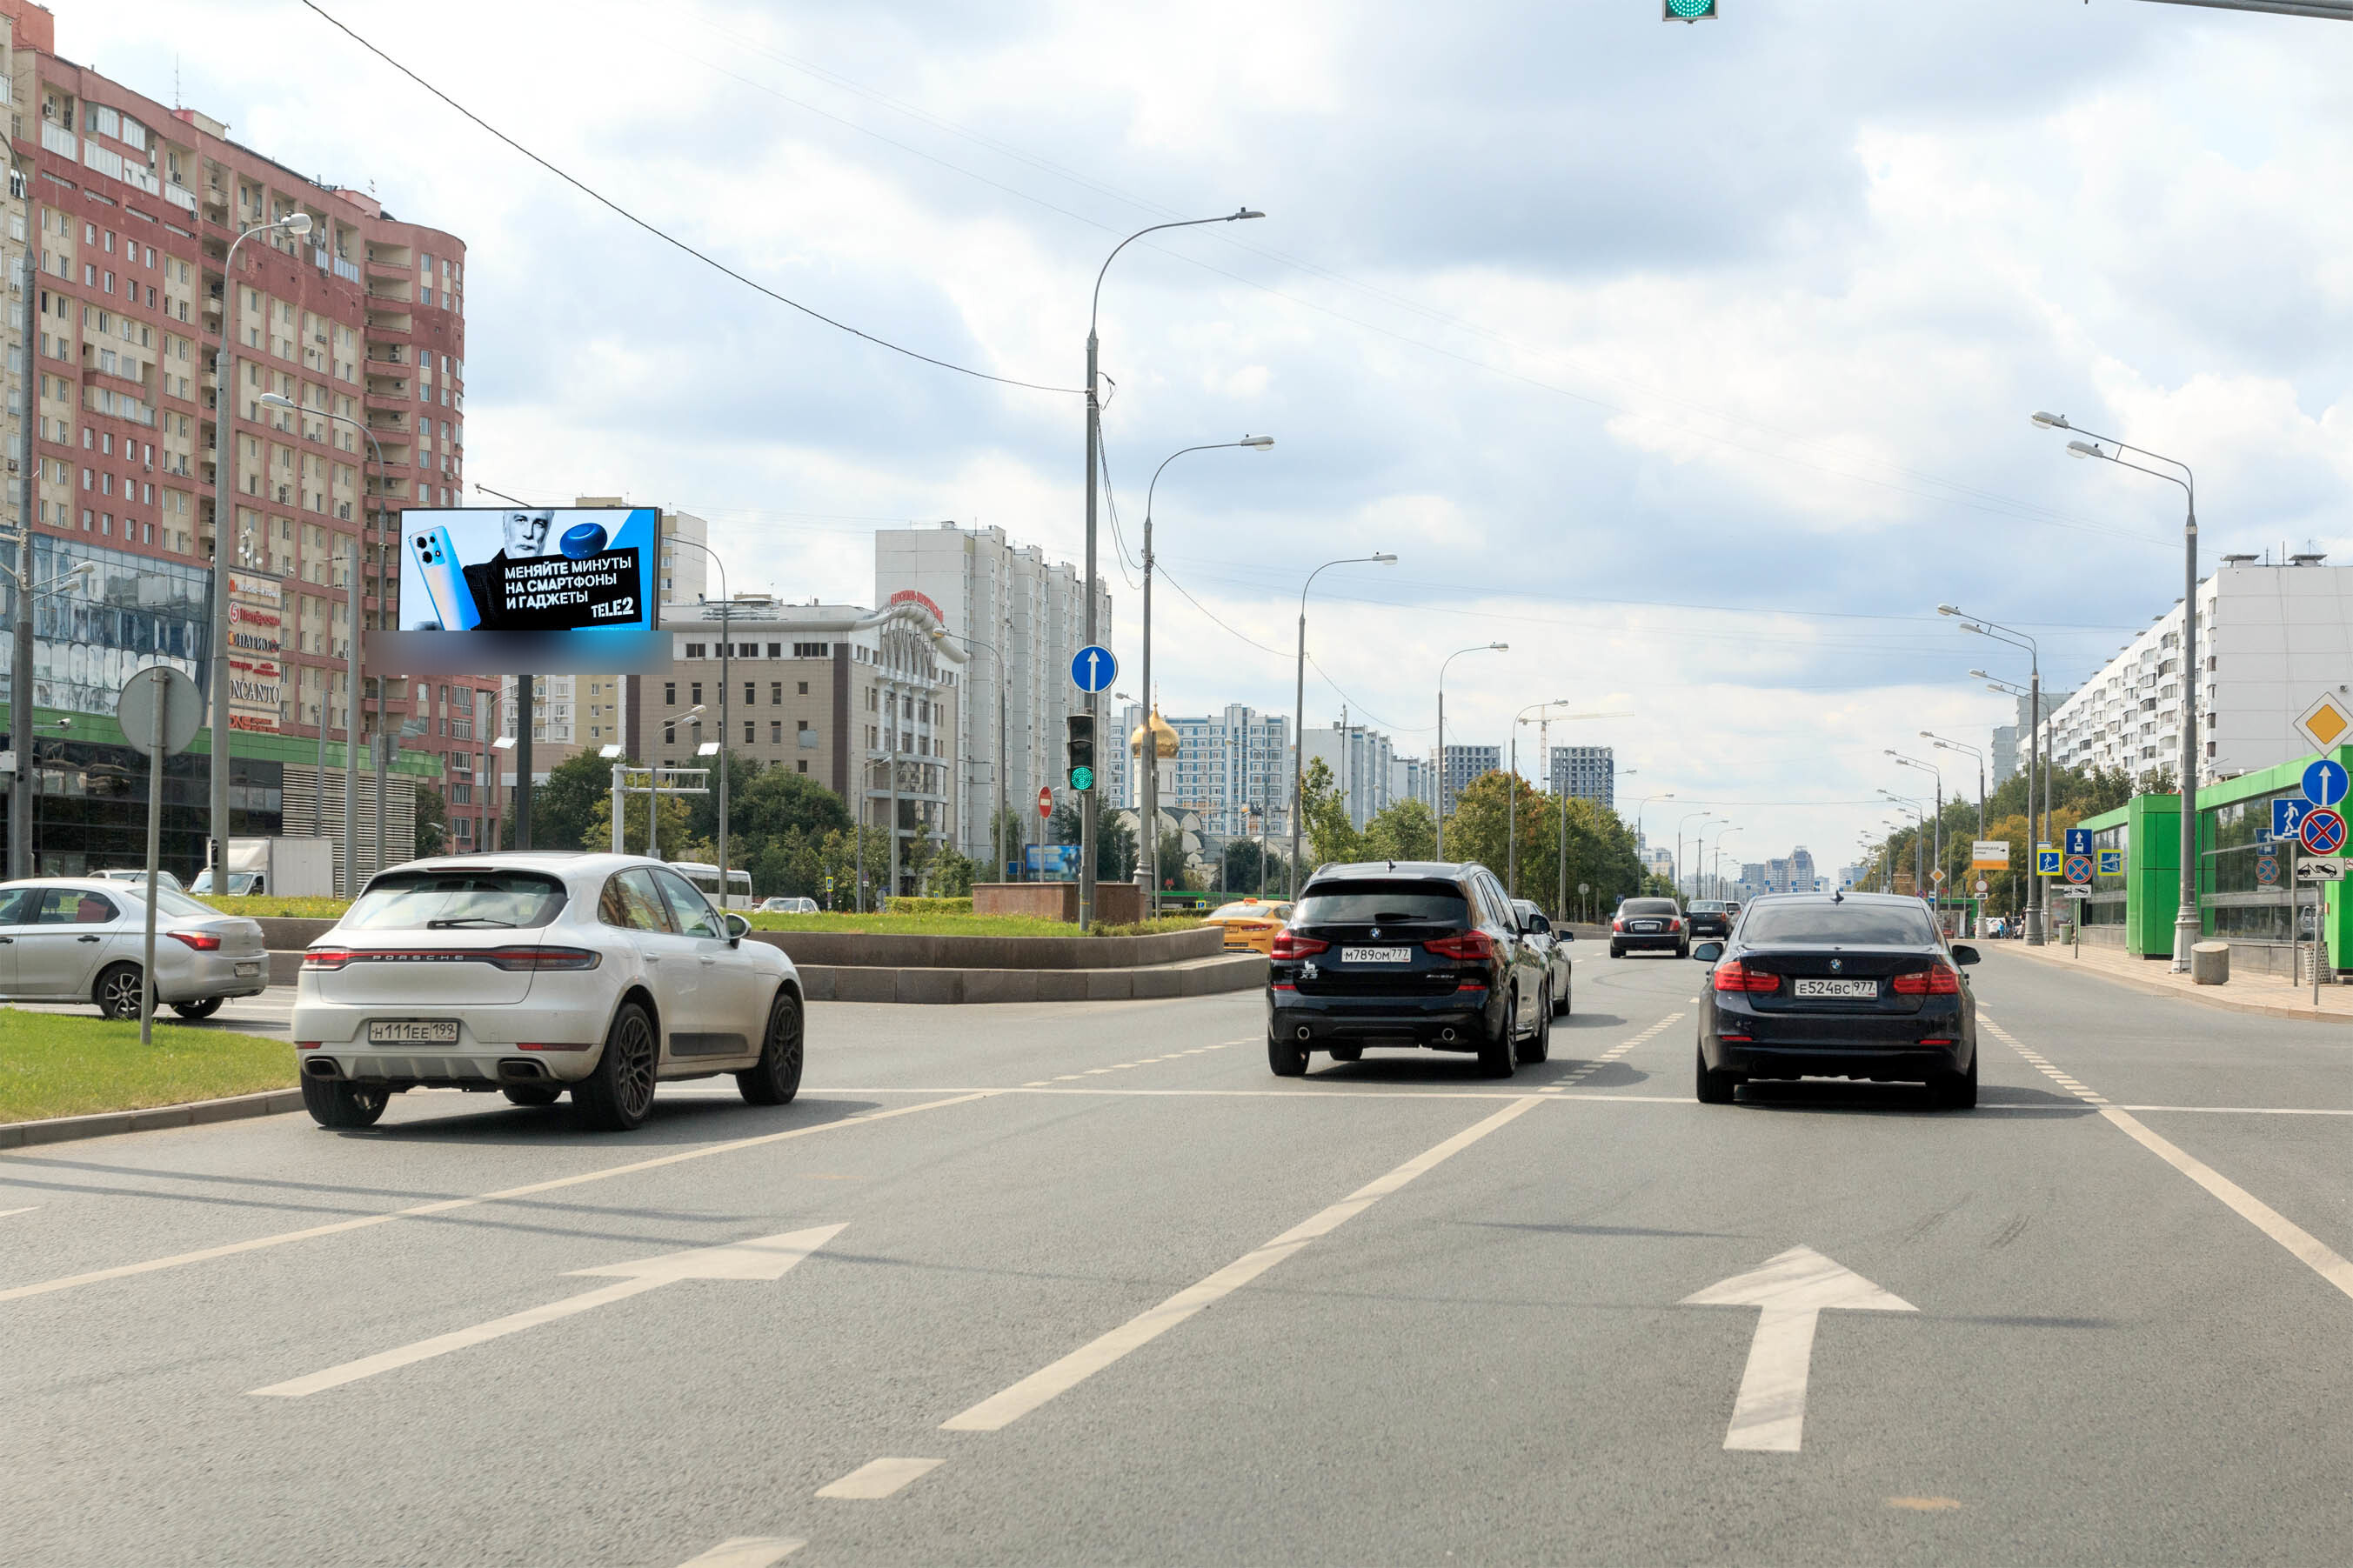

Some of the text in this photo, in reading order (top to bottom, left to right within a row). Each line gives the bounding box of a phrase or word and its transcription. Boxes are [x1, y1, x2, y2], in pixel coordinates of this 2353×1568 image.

[505, 557, 632, 579] МЕНЯЙТЕ МИНУТЫ
[505, 572, 617, 594] НА СМАРТФОНЫ
[506, 591, 588, 610] И ГАДЖЕТЫ
[592, 597, 634, 617] TELE2
[230, 679, 281, 704] NCANTO
[1345, 949, 1408, 960] М789ОМ 777
[1799, 981, 1874, 994] Е524ВС 977
[374, 1024, 454, 1039] Н111ЕЕ 199
